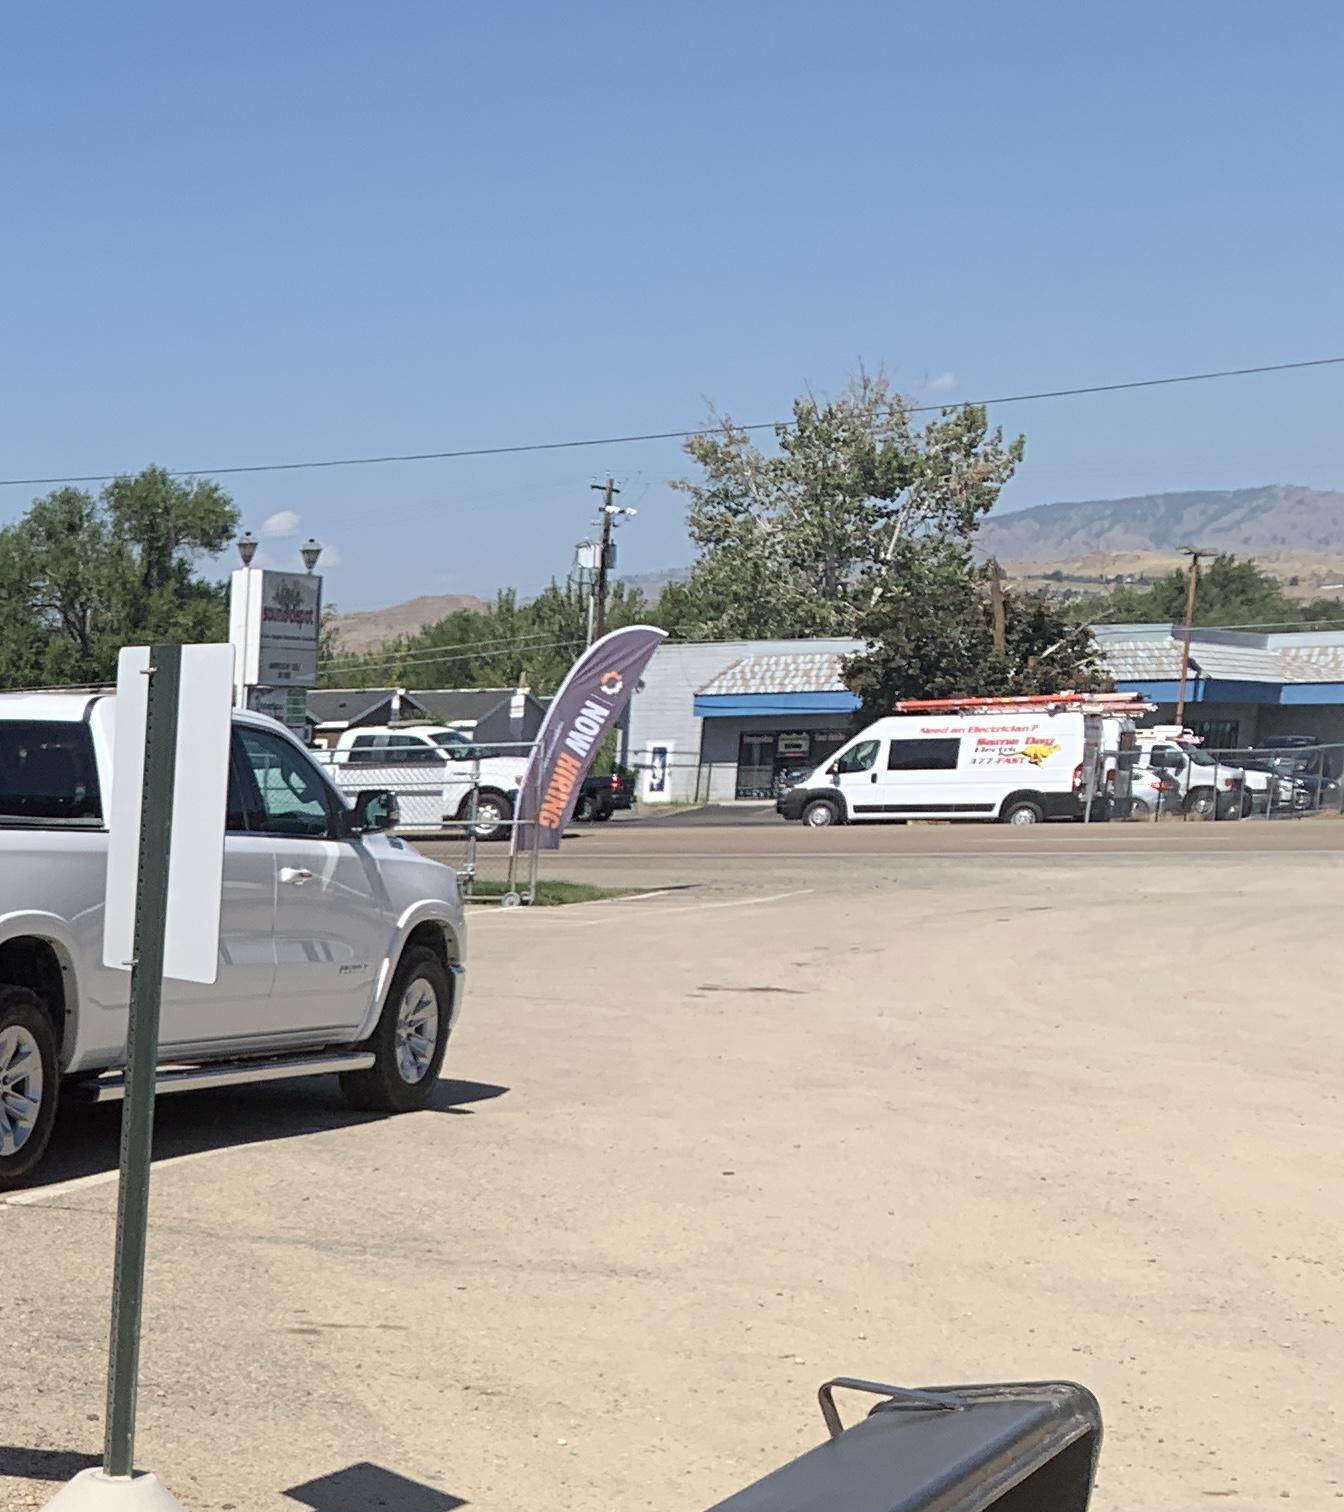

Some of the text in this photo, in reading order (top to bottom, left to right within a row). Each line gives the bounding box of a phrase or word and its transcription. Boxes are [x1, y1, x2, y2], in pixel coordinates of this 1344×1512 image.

[967, 725, 1039, 734] Electrician?
[976, 737, 1055, 747] Same Day
[539, 700, 611, 830] NOW HIRING
